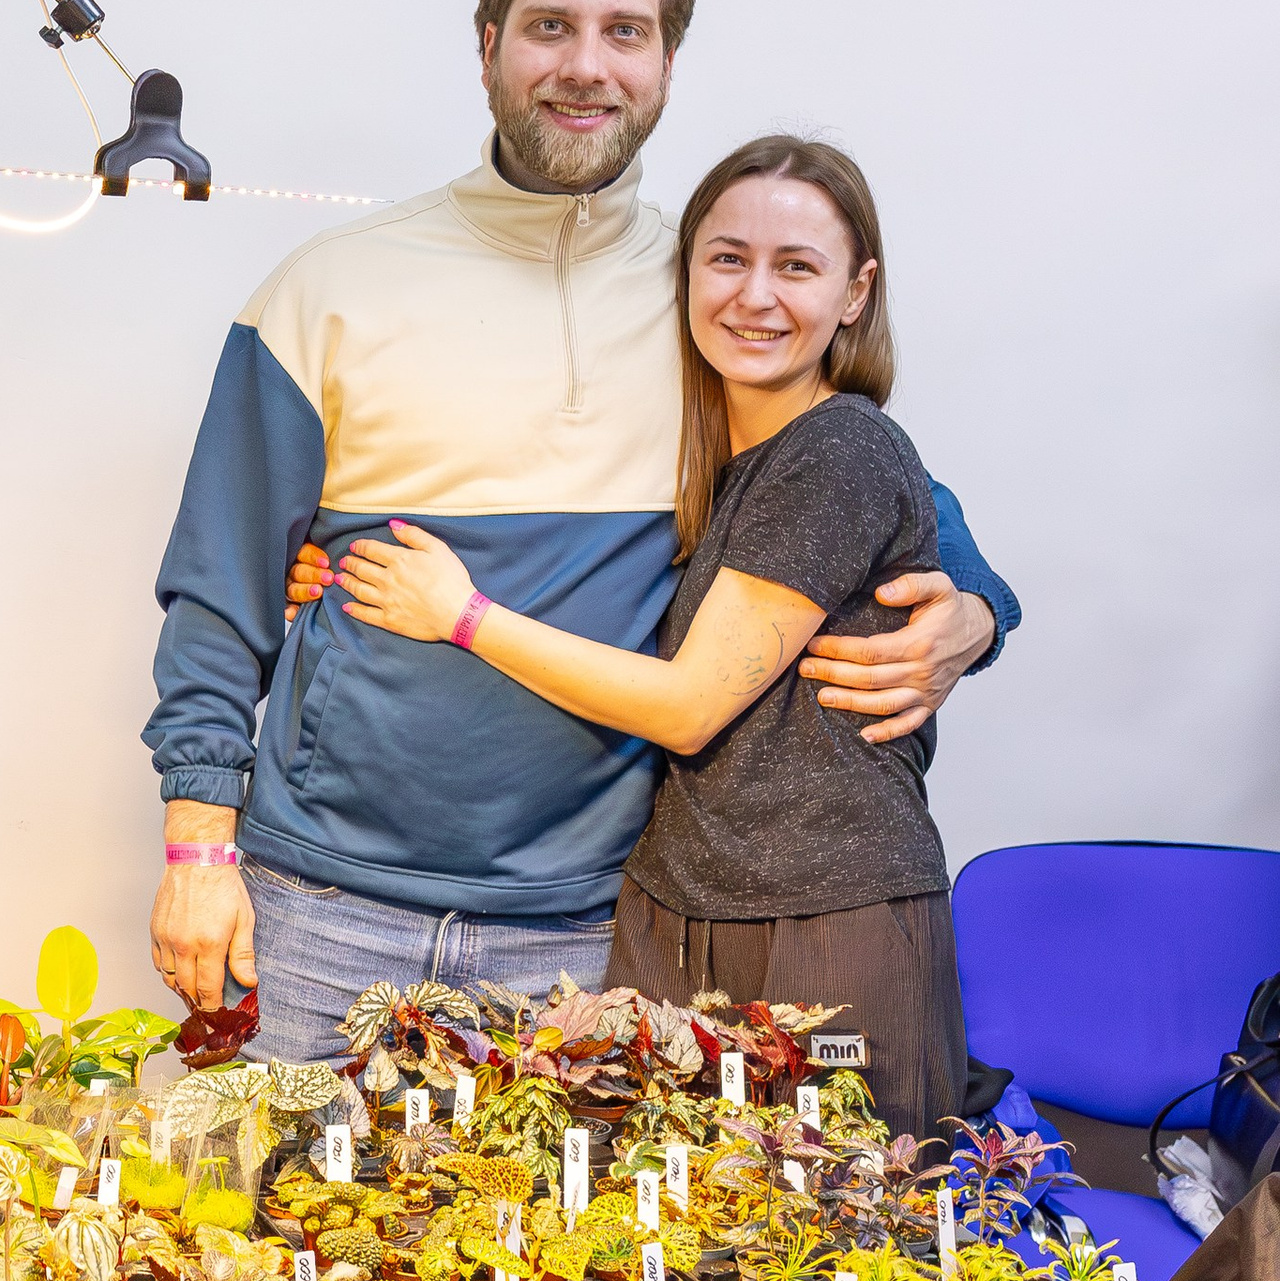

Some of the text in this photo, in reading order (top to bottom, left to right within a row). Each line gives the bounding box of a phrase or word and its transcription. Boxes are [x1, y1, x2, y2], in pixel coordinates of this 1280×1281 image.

[725, 1063, 735, 1084] 500
[569, 1138, 580, 1163] 600
[641, 1179, 651, 1204] 900
[299, 1257, 312, 1281] 600
[646, 1255, 658, 1281] 800
